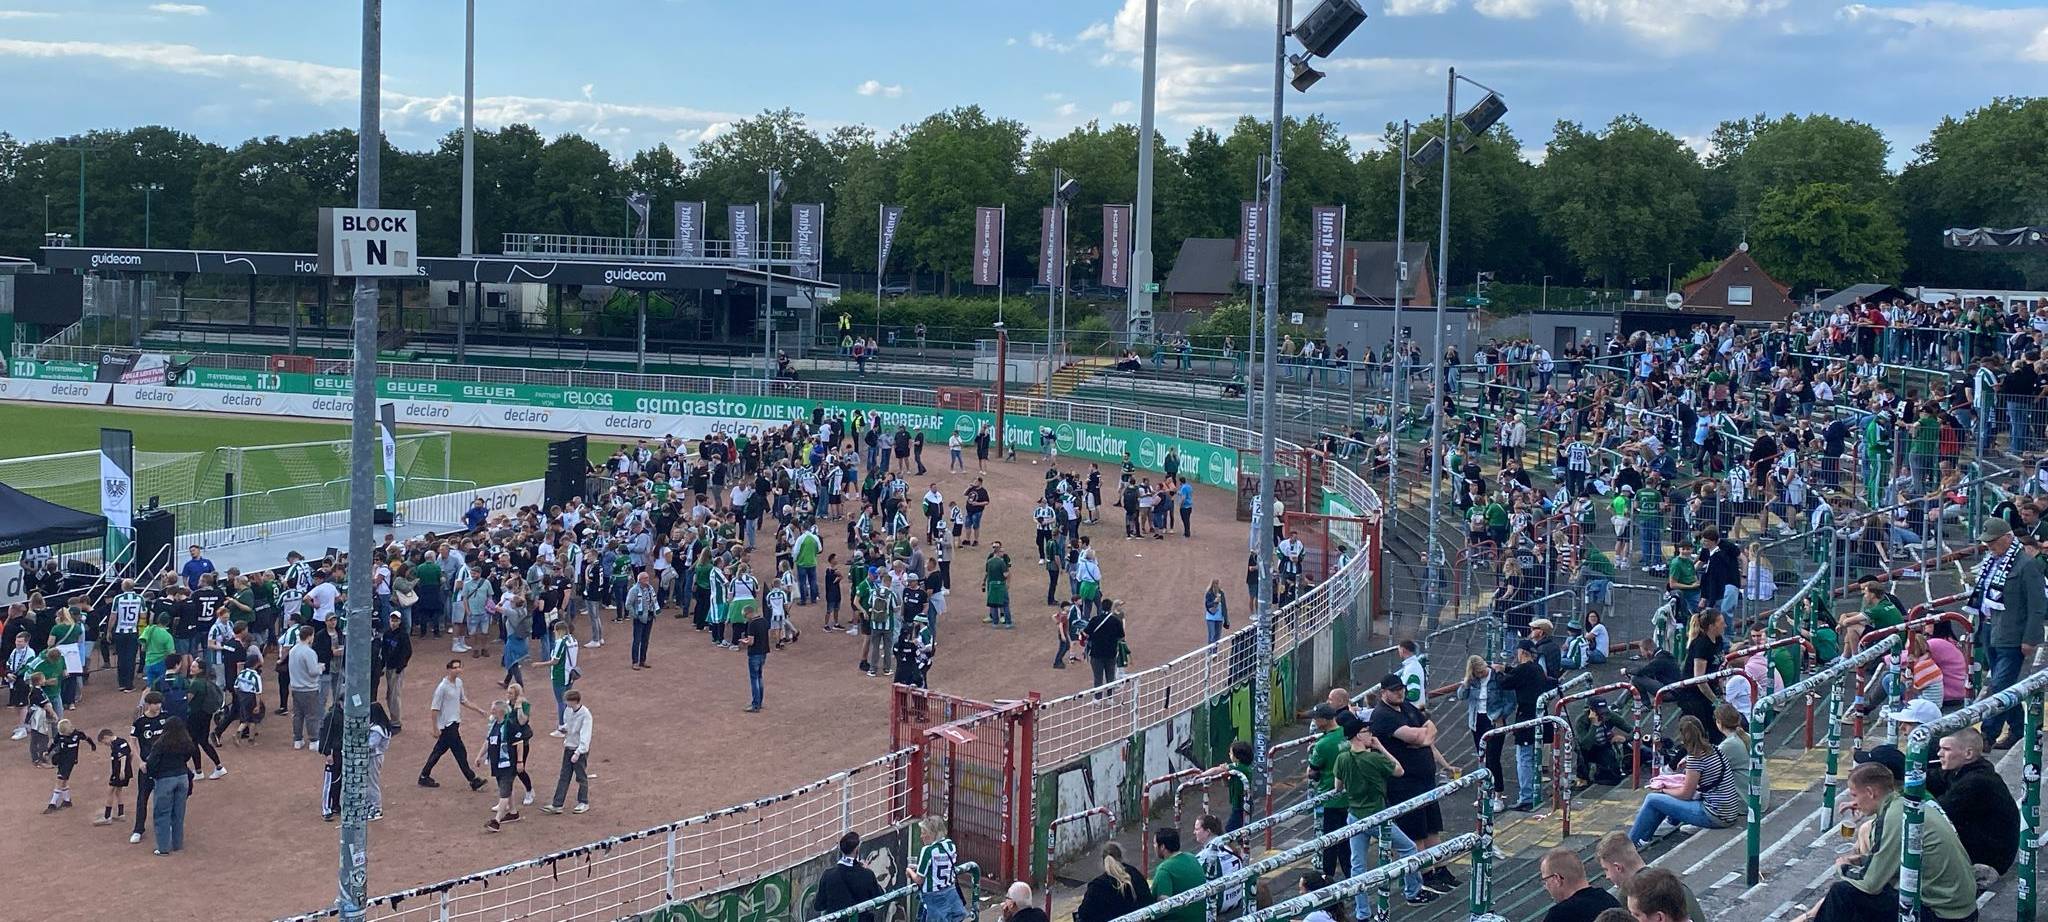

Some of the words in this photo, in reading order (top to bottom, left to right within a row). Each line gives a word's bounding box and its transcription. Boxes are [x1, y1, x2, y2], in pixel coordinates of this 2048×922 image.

[342, 216, 408, 232] BLOCK
[91, 252, 141, 267] guidecom
[366, 239, 387, 265] N
[604, 267, 667, 283] guidecom
[52, 383, 90, 397] declaro
[314, 378, 353, 389] GEUE
[387, 381, 438, 394] GEUER
[135, 388, 174, 402] declaro
[463, 385, 516, 398] GEUER
[222, 392, 262, 407] declaro
[406, 403, 449, 418] declaro
[504, 408, 549, 423] declaro
[787, 405, 809, 420] NR.
[604, 414, 653, 430] declaro
[1076, 427, 1127, 457] Warsteiner
[121, 606, 138, 621] 15
[200, 601, 216, 616] 15
[1913, 729, 1925, 742] 12
